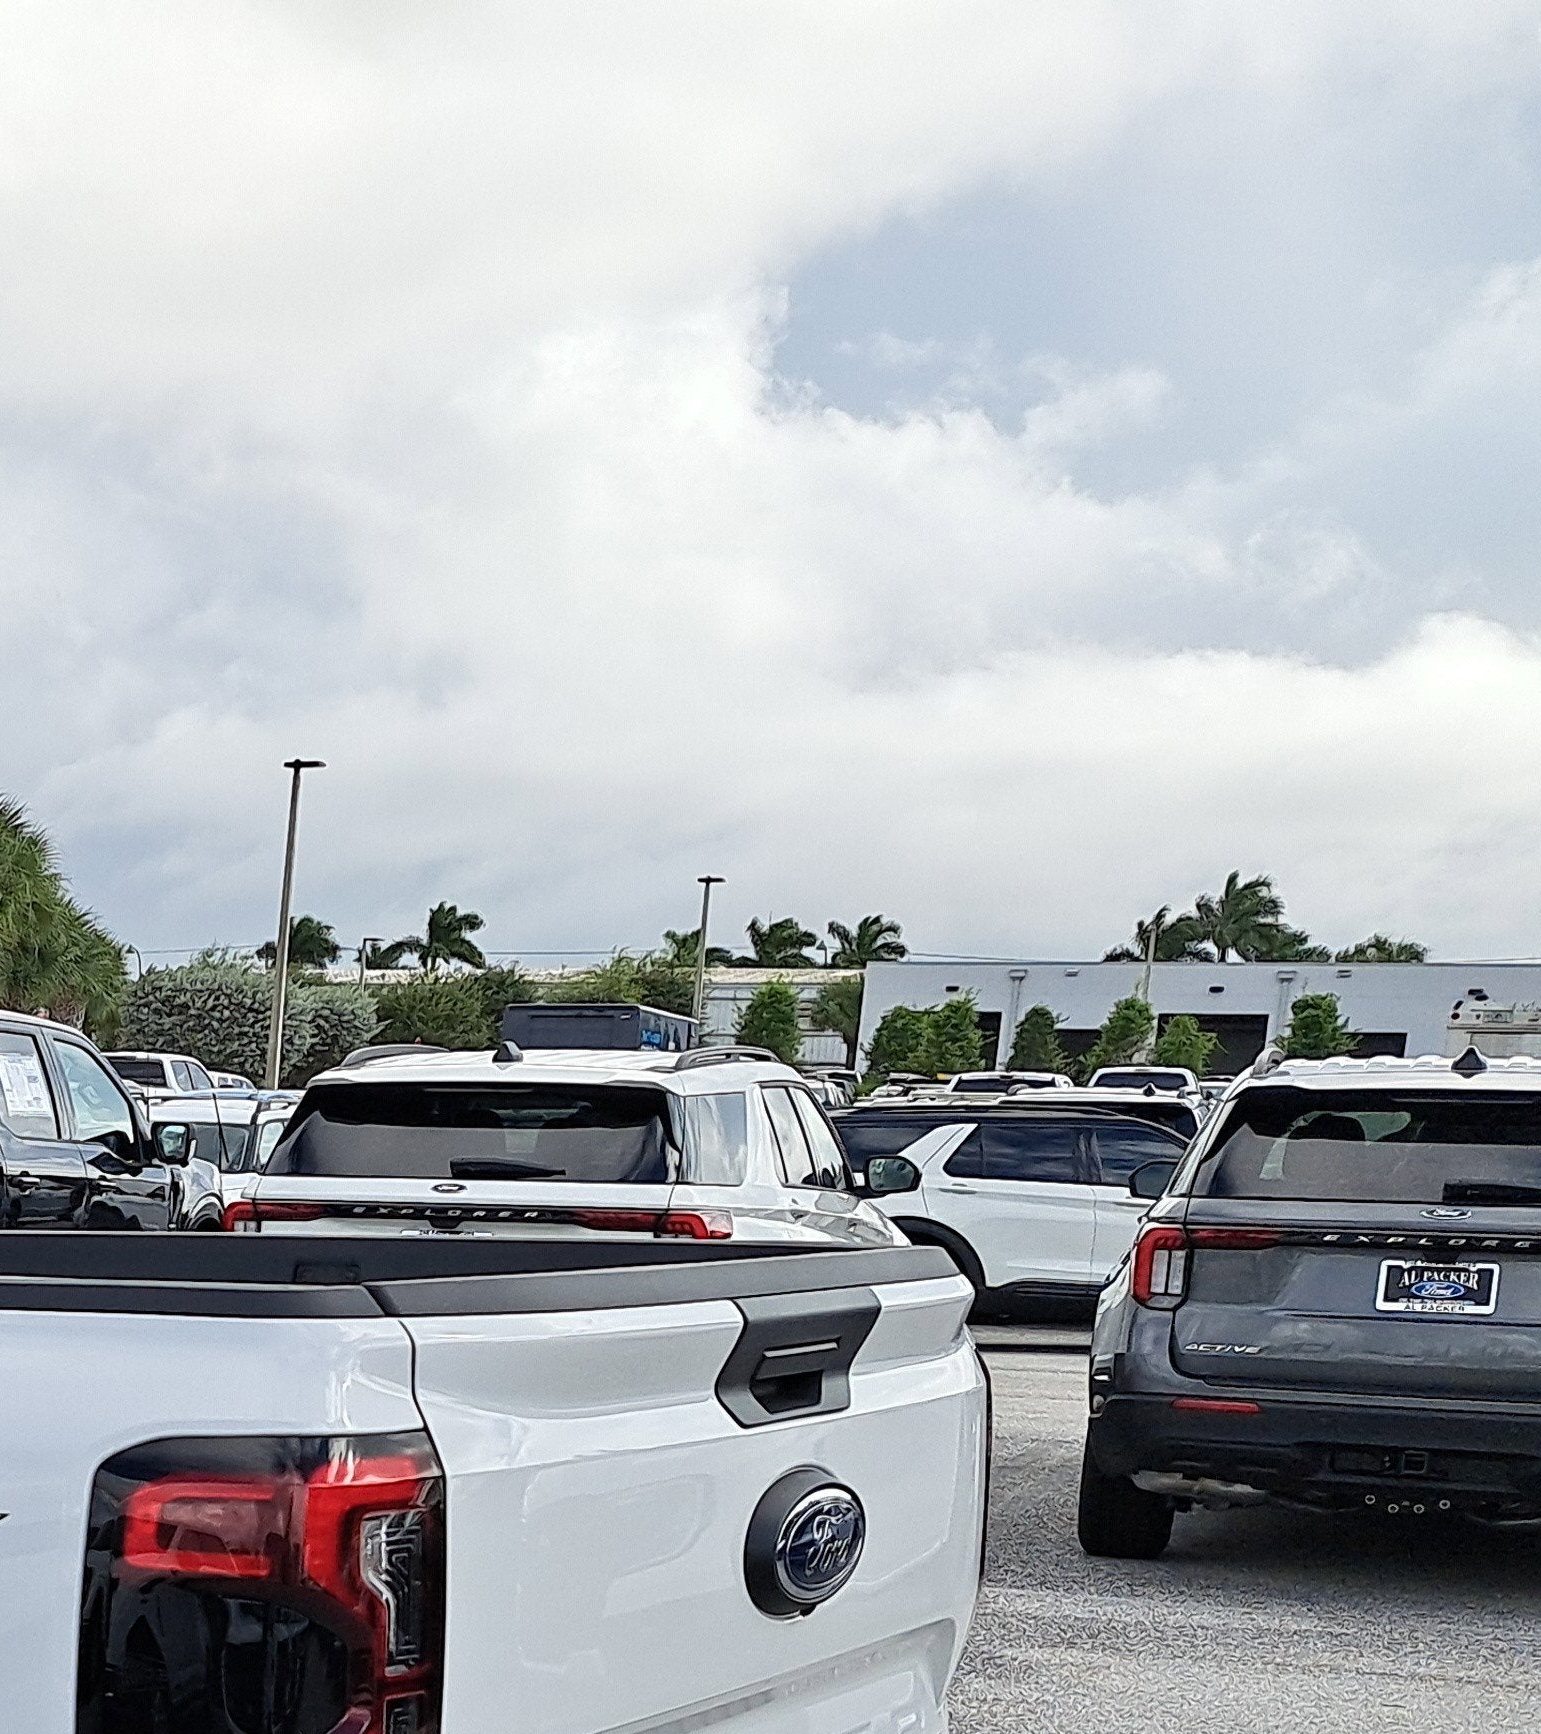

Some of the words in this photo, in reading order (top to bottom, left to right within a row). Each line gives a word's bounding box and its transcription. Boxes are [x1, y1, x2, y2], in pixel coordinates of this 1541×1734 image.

[352, 1205, 539, 1219] EXPLORER
[1398, 1270, 1420, 1288] AL
[1423, 1271, 1479, 1291] PACKER
[1185, 1343, 1261, 1355] ACTIVE
